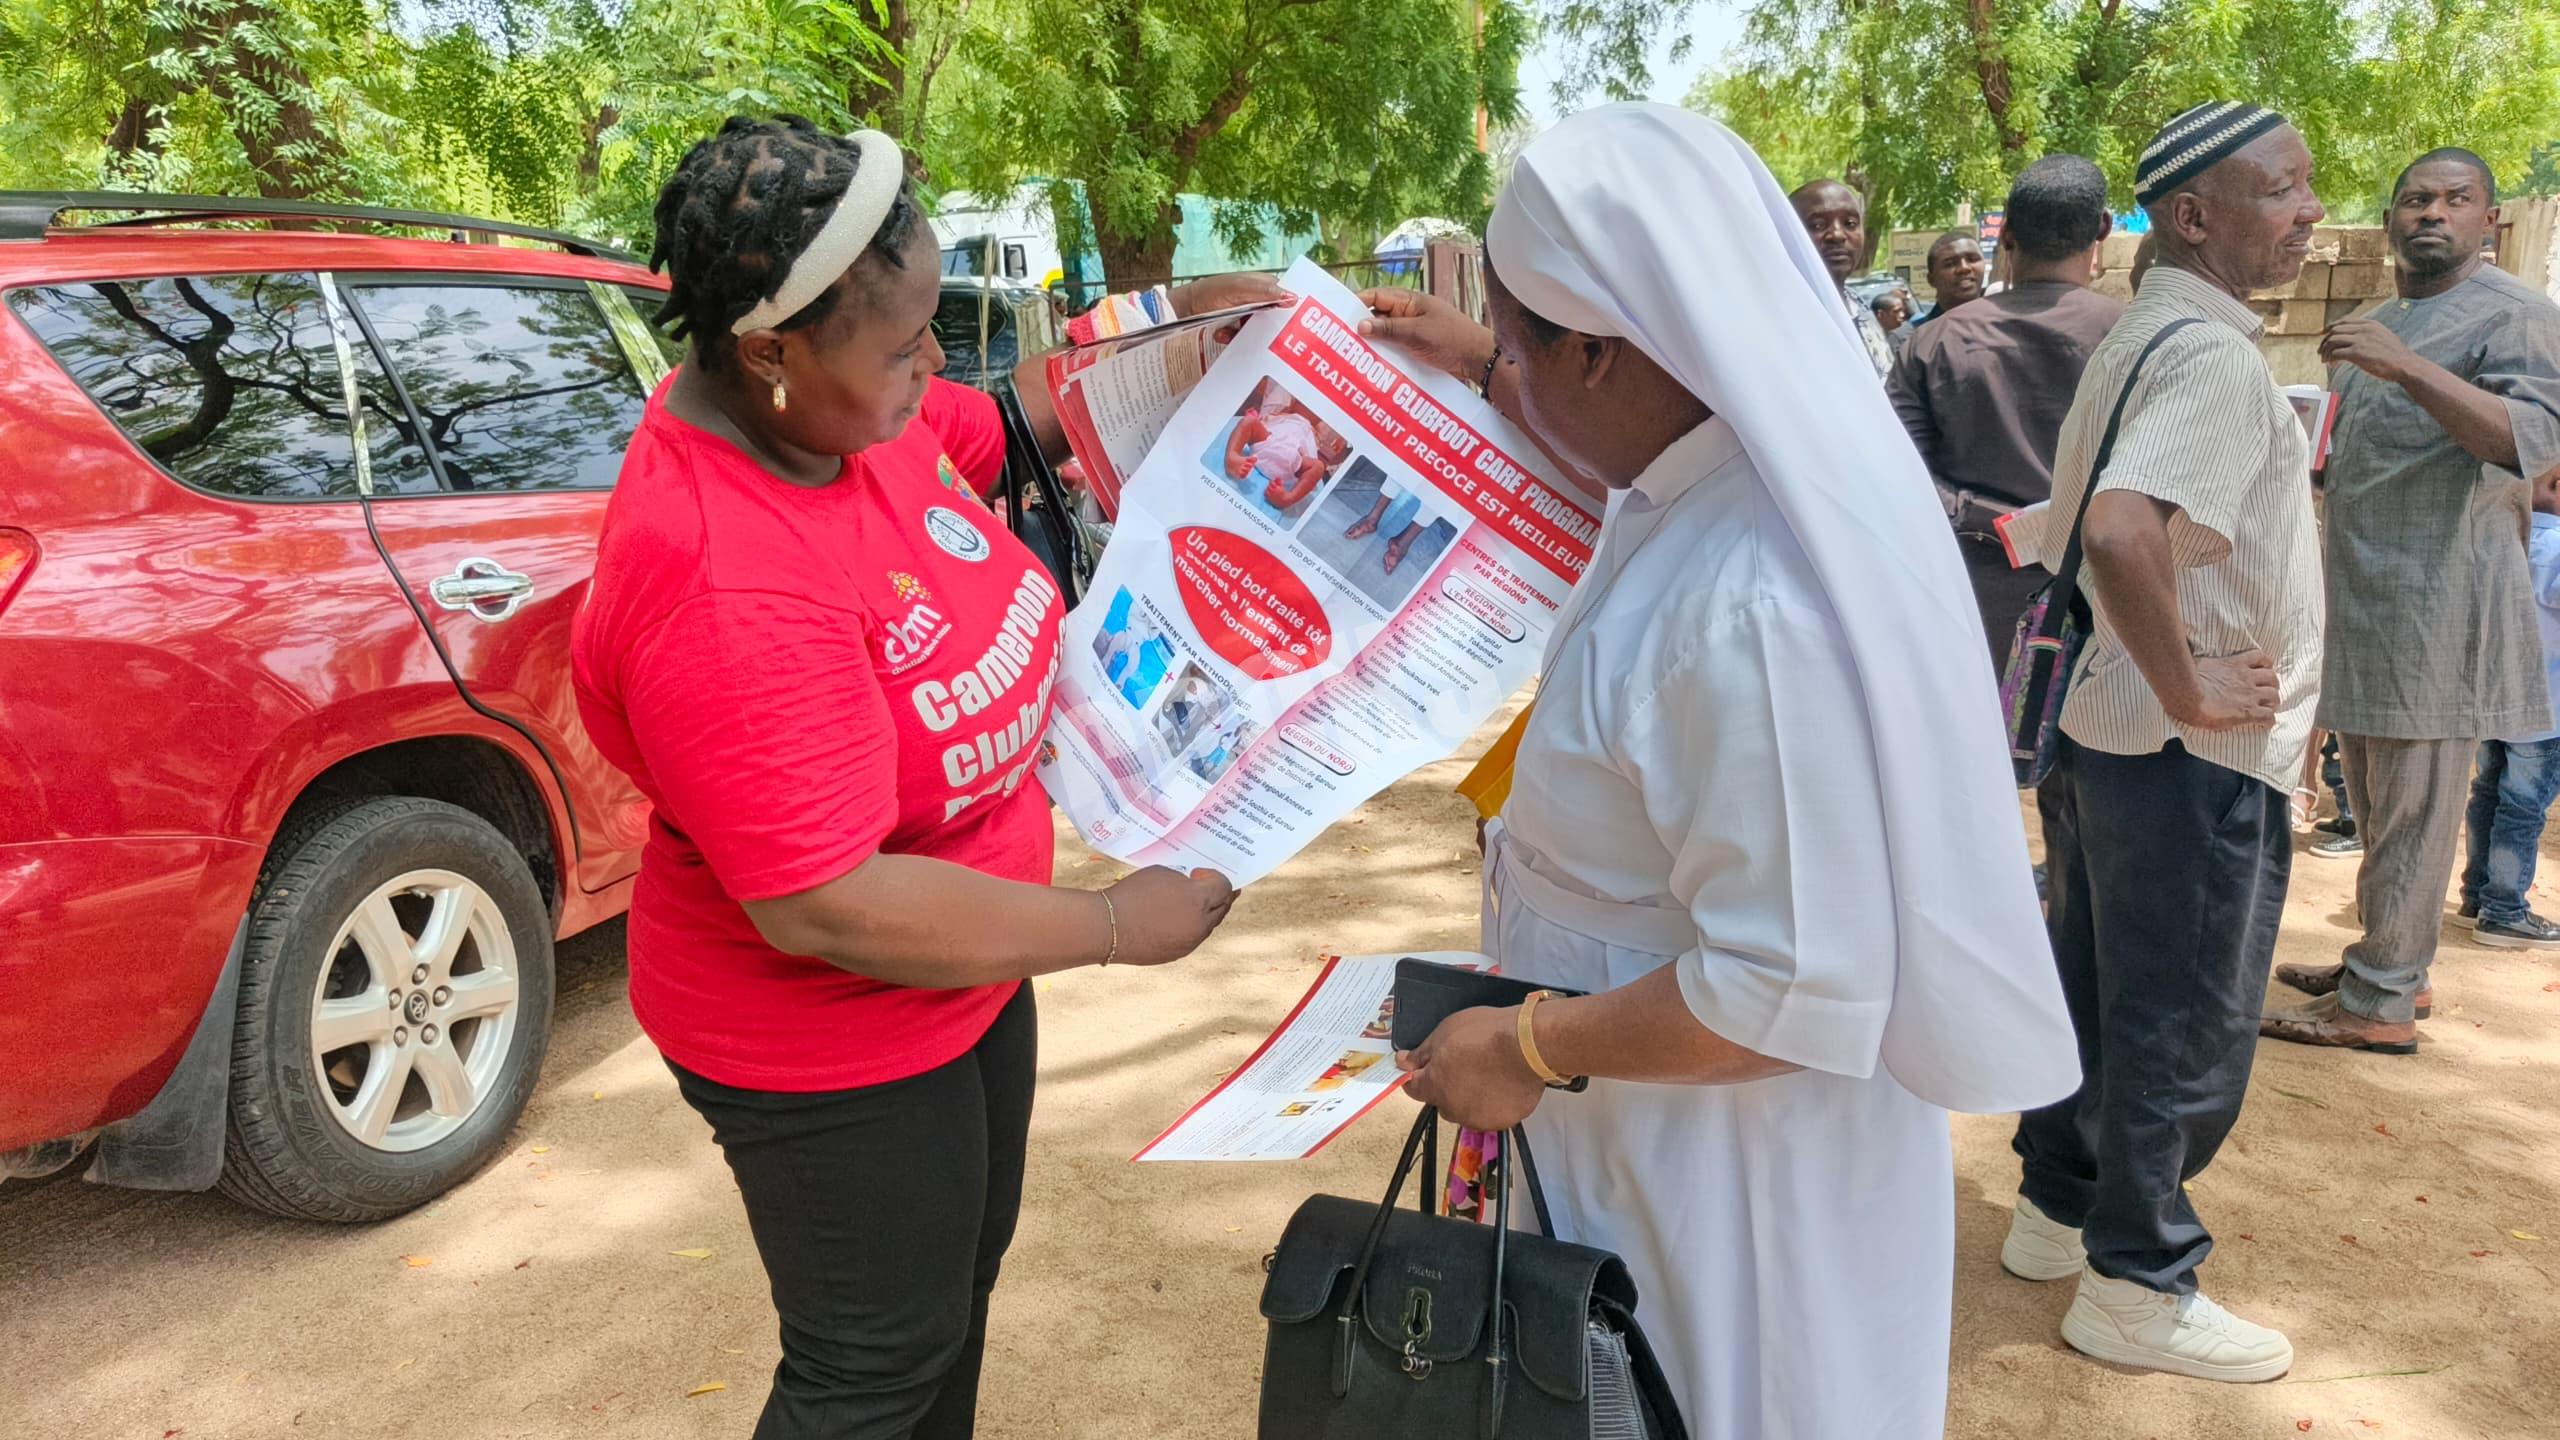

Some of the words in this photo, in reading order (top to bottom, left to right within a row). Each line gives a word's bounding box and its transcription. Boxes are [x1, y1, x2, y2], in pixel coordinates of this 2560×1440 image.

[1299, 306, 1398, 391] CAMEROON
[1391, 382, 1478, 459] CLUBFOOT
[1474, 447, 1524, 493] CARE
[1283, 334, 1305, 355] LE
[1305, 353, 1403, 438] TRAITEMENT
[1404, 435, 1475, 494] PRECOCE
[1476, 489, 1508, 519] EST
[1509, 514, 1586, 575] MEILLEUR
[1199, 474, 1215, 489] PIED
[1214, 486, 1228, 499] BOT
[1234, 502, 1242, 511] LA
[1241, 507, 1274, 536] NAISSANCE
[1287, 544, 1302, 558] PIED
[1301, 555, 1315, 568] BOT
[1186, 531, 1209, 553] Un
[1207, 548, 1241, 580] pied
[1241, 574, 1267, 599] bot
[1266, 593, 1305, 629] traité
[1304, 623, 1327, 646] tôt
[1459, 539, 1496, 568] CENTRES
[1496, 565, 1508, 576] DE
[1508, 573, 1558, 612] TRAITEMENT
[1473, 563, 1491, 579] PAR
[1491, 575, 1527, 605] RÉGIONS
[1173, 554, 1223, 609] marcher
[1219, 608, 1297, 677] normalement
[1182, 547, 1231, 594] permet
[1229, 592, 1239, 602] à
[1238, 598, 1291, 646] l'enfant
[1289, 640, 1307, 658] de
[1494, 609, 1505, 619] DE
[885, 604, 941, 663] cbm
[1139, 594, 1182, 642] TRAITEMENT
[1180, 641, 1197, 659] PAR
[1405, 619, 1414, 627] de
[1414, 625, 1437, 643] Maroua
[1413, 611, 1433, 628] Centre
[1433, 625, 1466, 651] Hospitalier
[1428, 595, 1453, 616] Meskine
[1452, 613, 1475, 632] Baptist
[1474, 628, 1501, 650] Hospital
[1458, 629, 1467, 638] de
[911, 568, 1056, 733] Cameroon
[1376, 647, 1397, 665] Centre
[1426, 683, 1440, 696] Yves
[1437, 666, 1461, 685] Annexe
[1460, 682, 1469, 691] de
[1444, 658, 1453, 667] de
[1453, 664, 1478, 685] Maroua
[1417, 703, 1426, 713] de
[1382, 731, 1391, 739] de
[1314, 744, 1327, 755] DU
[1327, 752, 1352, 771] NORD
[1304, 781, 1313, 790] de
[1315, 774, 1336, 791] Garoua
[1284, 794, 1305, 812] Annexe
[1304, 808, 1313, 816] de
[1091, 819, 1112, 841] cbm
[1220, 820, 1228, 829] de
[1265, 823, 1272, 831] de
[1275, 816, 1294, 832] Garoua
[1230, 839, 1238, 847] de
